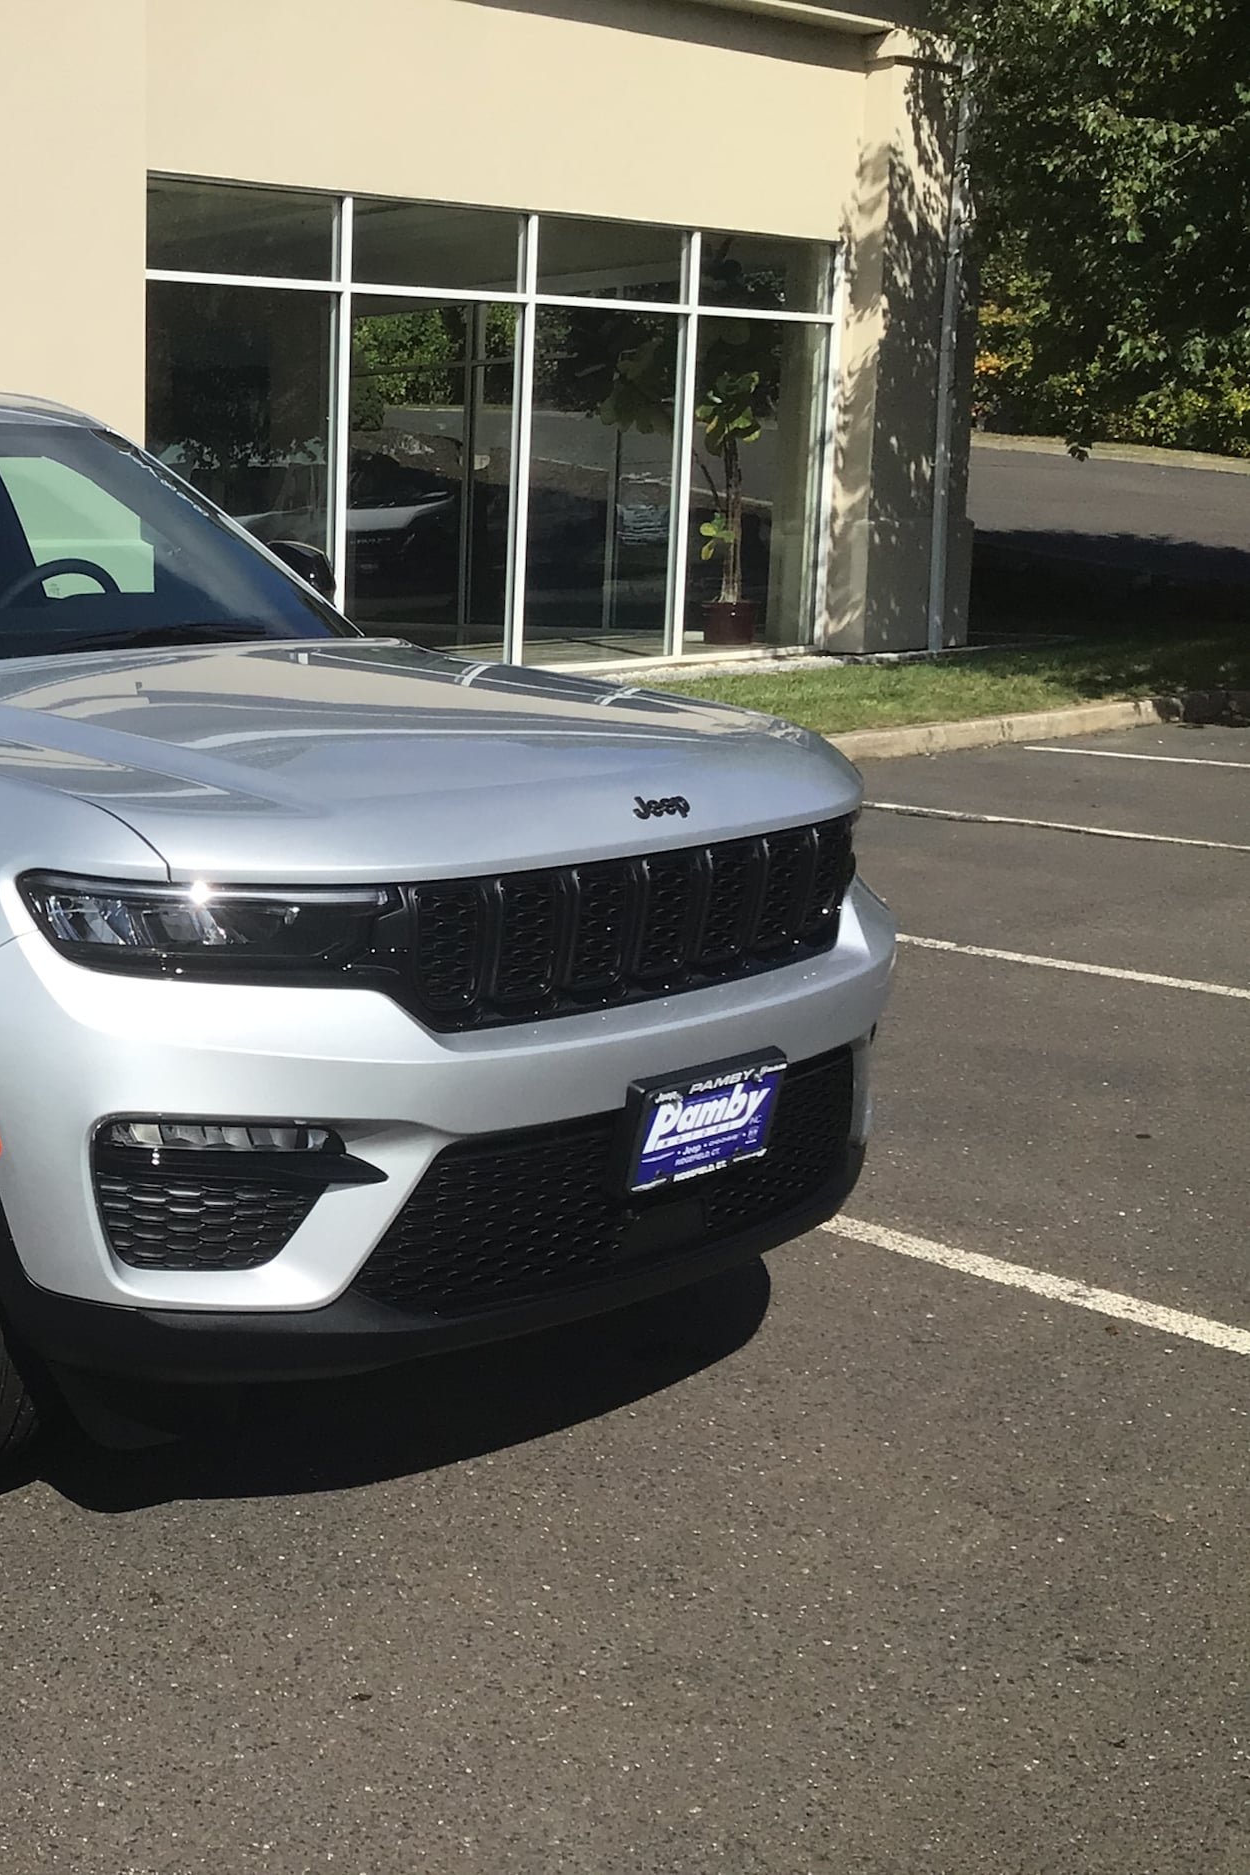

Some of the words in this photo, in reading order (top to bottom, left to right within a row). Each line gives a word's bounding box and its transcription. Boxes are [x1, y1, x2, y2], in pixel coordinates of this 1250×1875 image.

[632, 796, 691, 820] Jeep
[688, 1068, 755, 1095] PAMBY
[642, 1083, 771, 1154] Pamby
